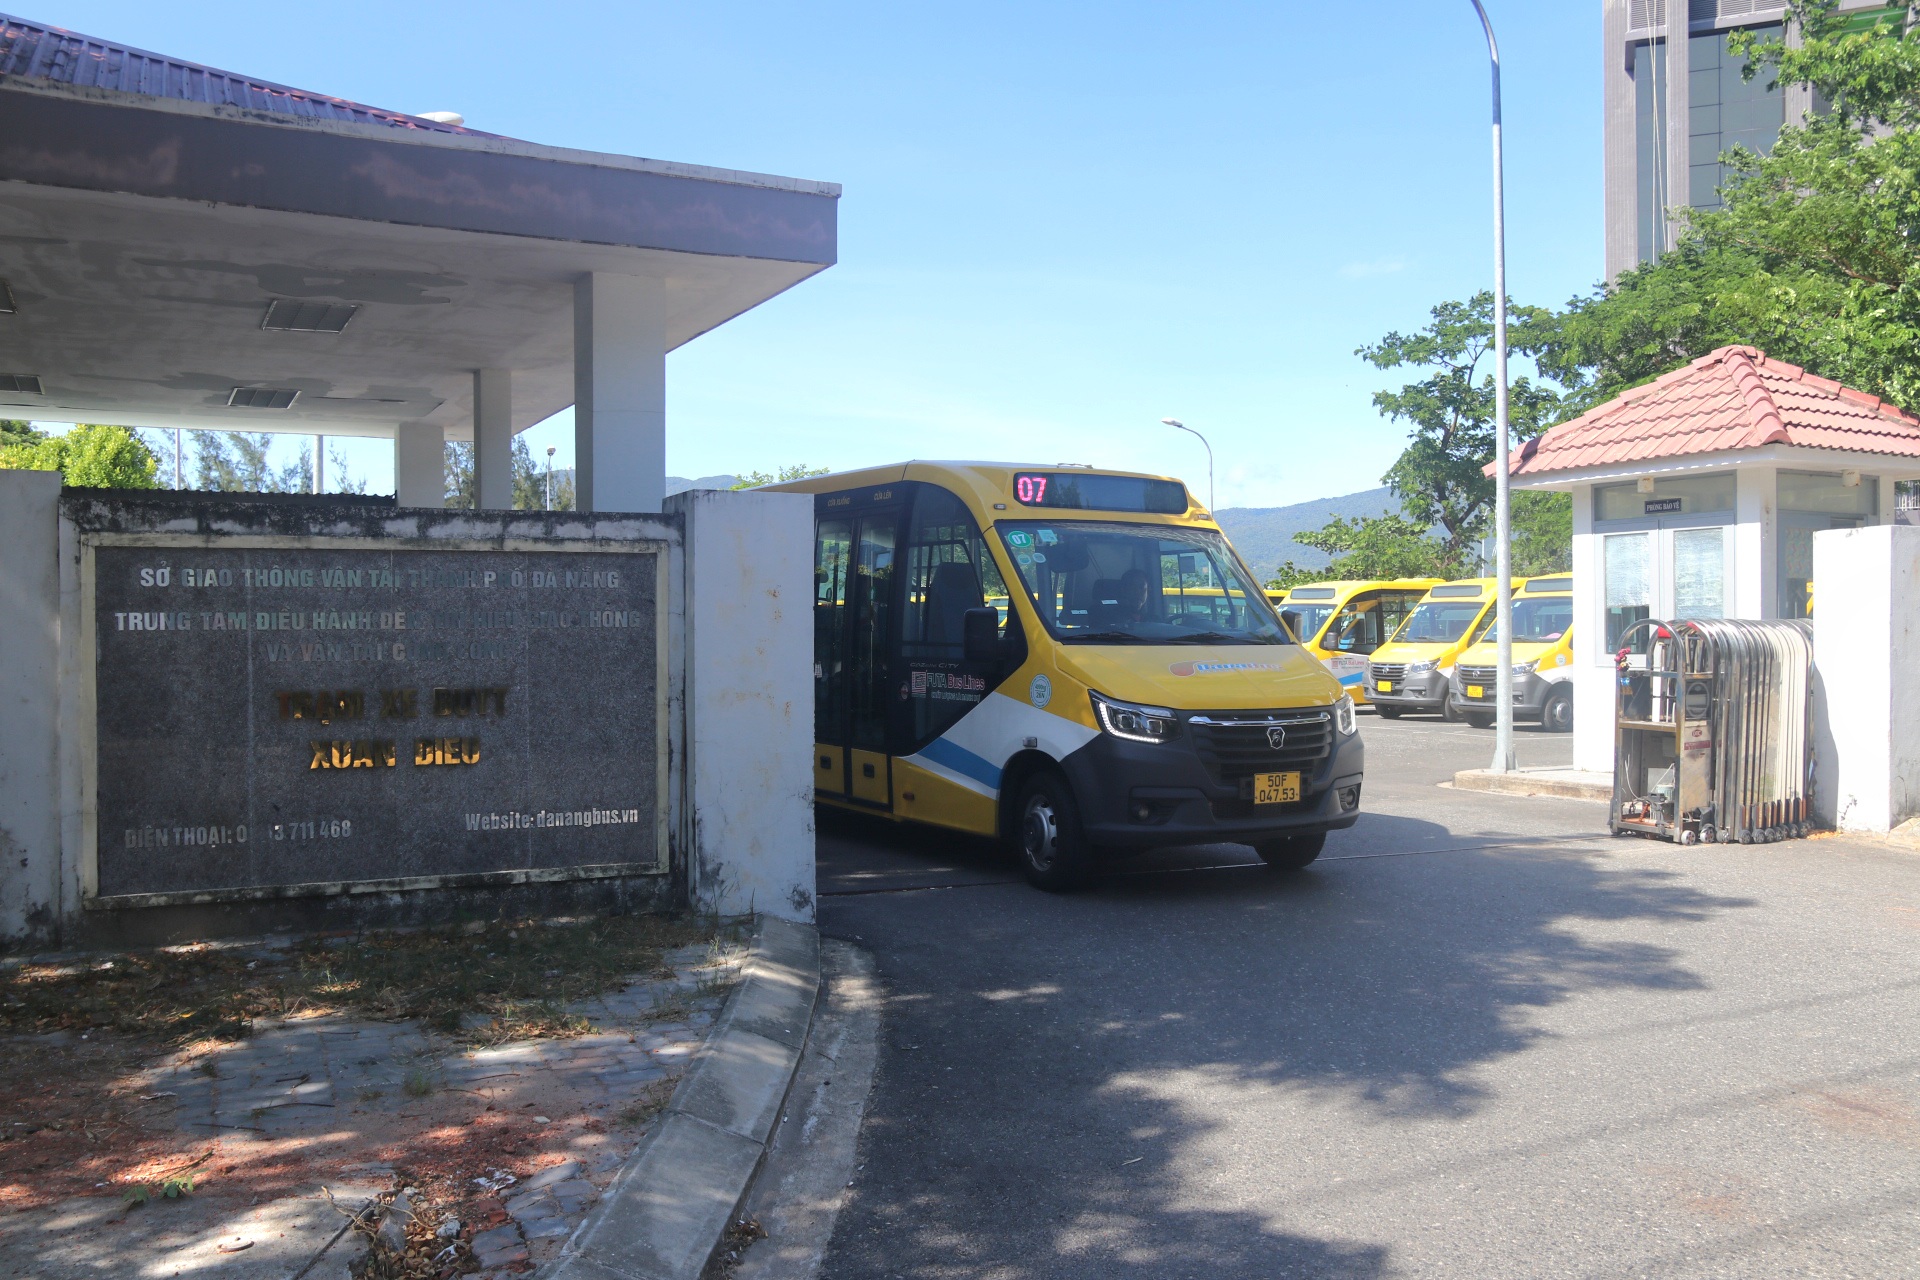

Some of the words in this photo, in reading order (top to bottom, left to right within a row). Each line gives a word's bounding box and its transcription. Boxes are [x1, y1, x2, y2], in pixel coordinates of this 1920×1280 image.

[1017, 476, 1047, 503] 07
[1011, 534, 1027, 545] 07
[140, 561, 170, 587] SỞ
[181, 568, 233, 587] GIAO
[242, 565, 314, 588] THÔNG
[321, 567, 362, 591] VẬN
[368, 563, 399, 588] TẢI
[115, 611, 191, 631] TRUNG
[256, 604, 305, 630] ĐIỀU
[312, 607, 371, 630] HÀNH
[579, 607, 641, 629] THÔNG
[927, 672, 947, 688] FUTA
[947, 673, 962, 689] Bus
[963, 674, 985, 690] Lines
[382, 688, 419, 719] XE
[1267, 774, 1287, 788] 50F
[1259, 787, 1295, 802] 047.53
[290, 821, 315, 840] 711
[320, 819, 352, 839] 468
[465, 811, 534, 831] Website:
[537, 807, 639, 829] danangbus.vn
